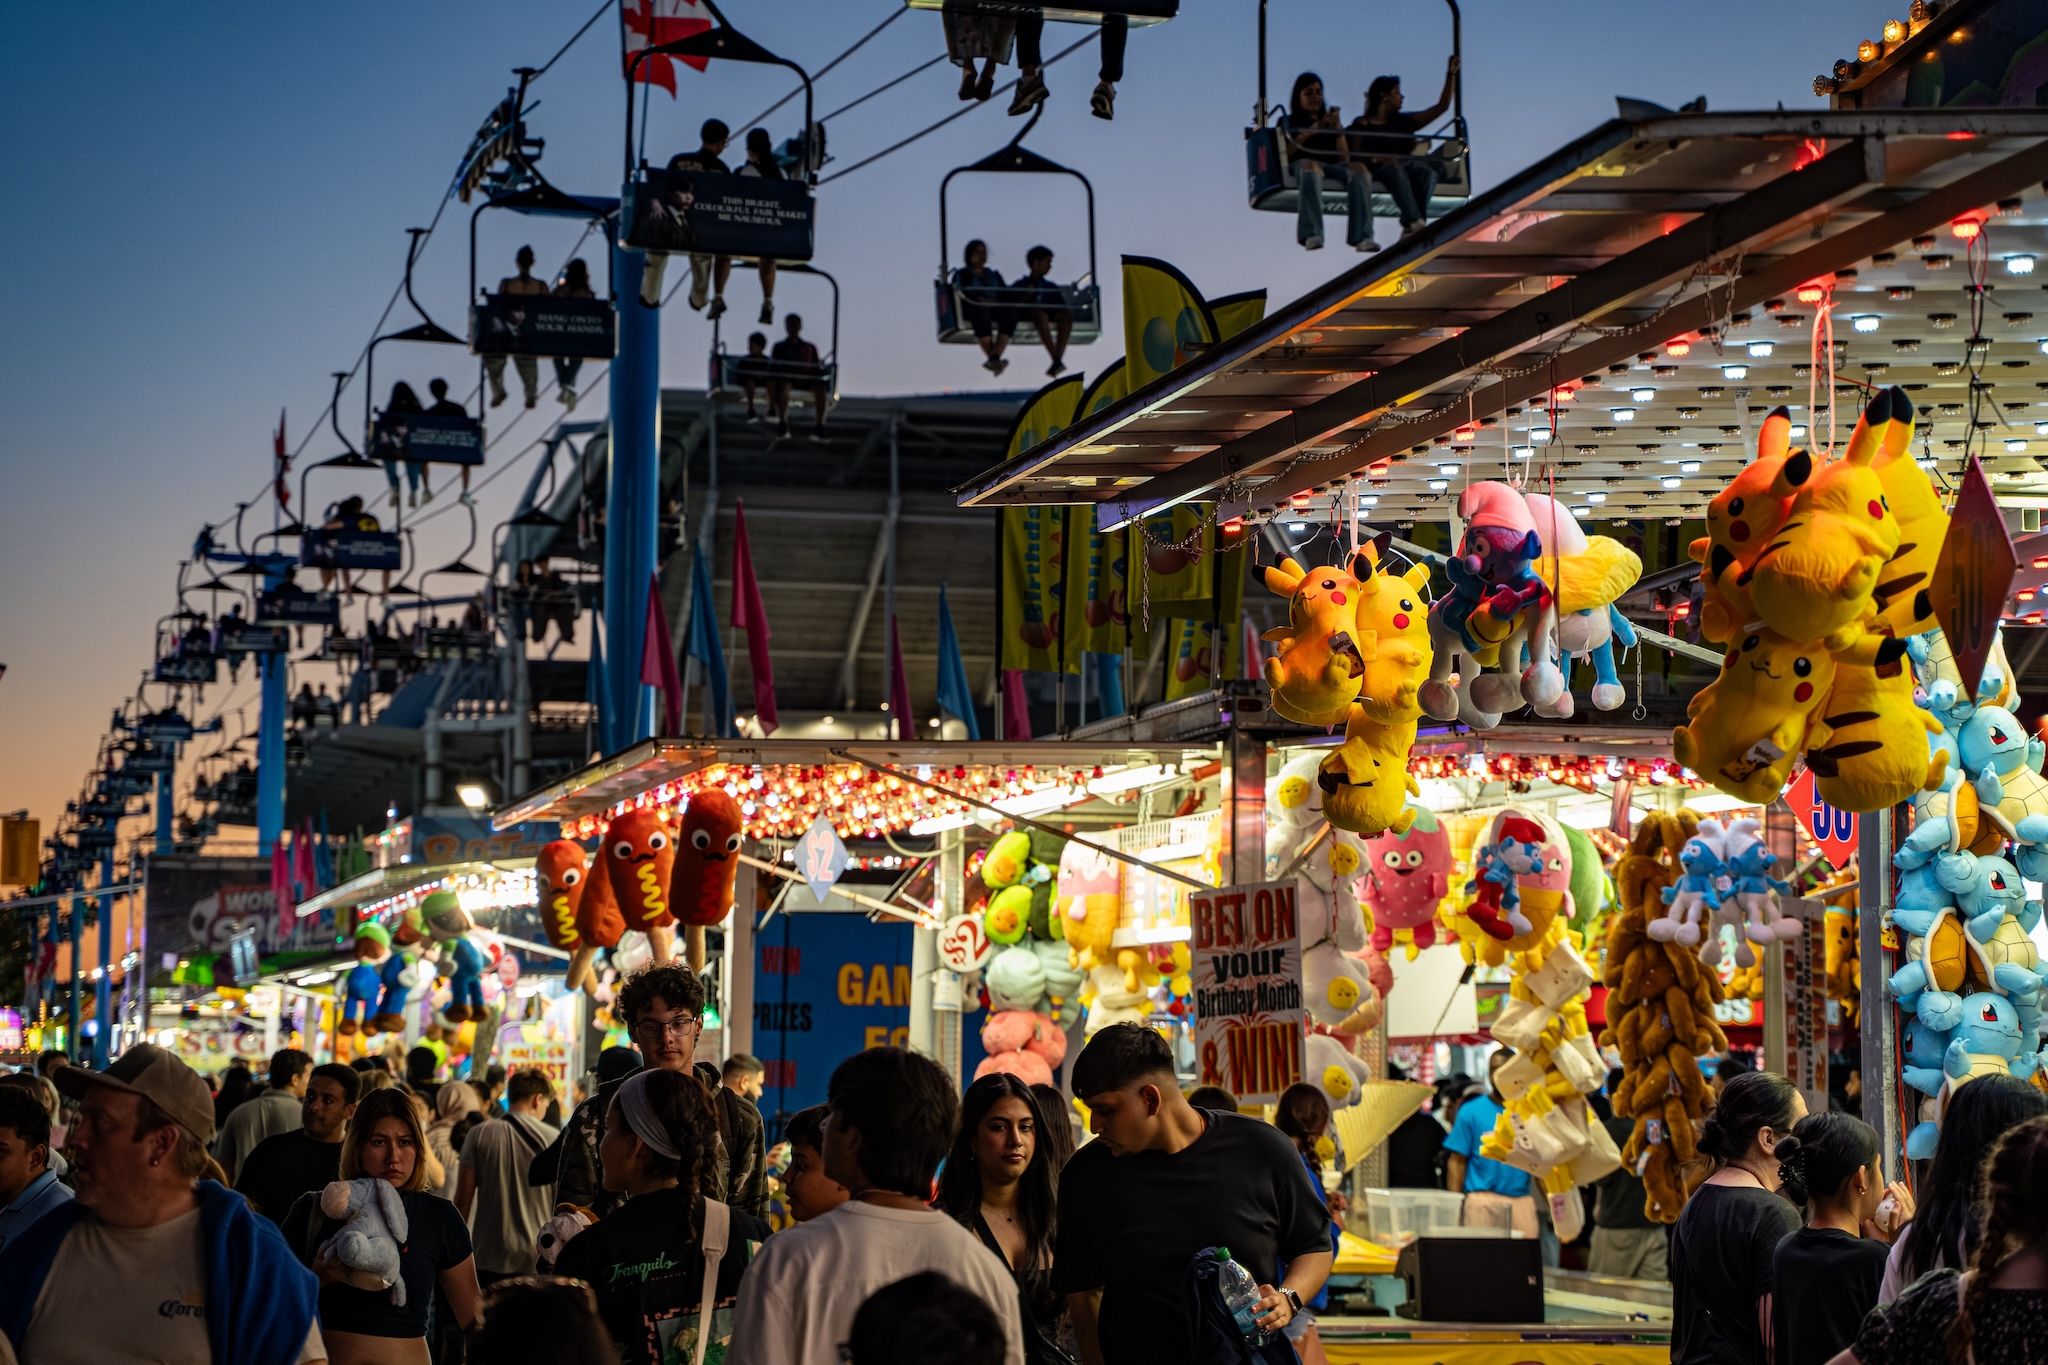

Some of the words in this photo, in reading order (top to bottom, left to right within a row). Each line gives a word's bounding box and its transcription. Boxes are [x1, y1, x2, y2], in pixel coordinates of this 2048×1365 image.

[1023, 506, 1042, 623] Birthda
[806, 830, 835, 882] $2
[1193, 892, 1247, 950] BET
[1253, 886, 1297, 943] ON
[943, 920, 990, 965] $2
[838, 962, 912, 1007] GAM
[1212, 948, 1286, 984] your
[1197, 985, 1254, 1019] Birthday
[1256, 978, 1301, 1013] Month
[1201, 1039, 1224, 1087] &
[1226, 1023, 1302, 1096] WIN!
[605, 1251, 681, 1284] Tranquilo
[159, 1300, 208, 1319] Coro
